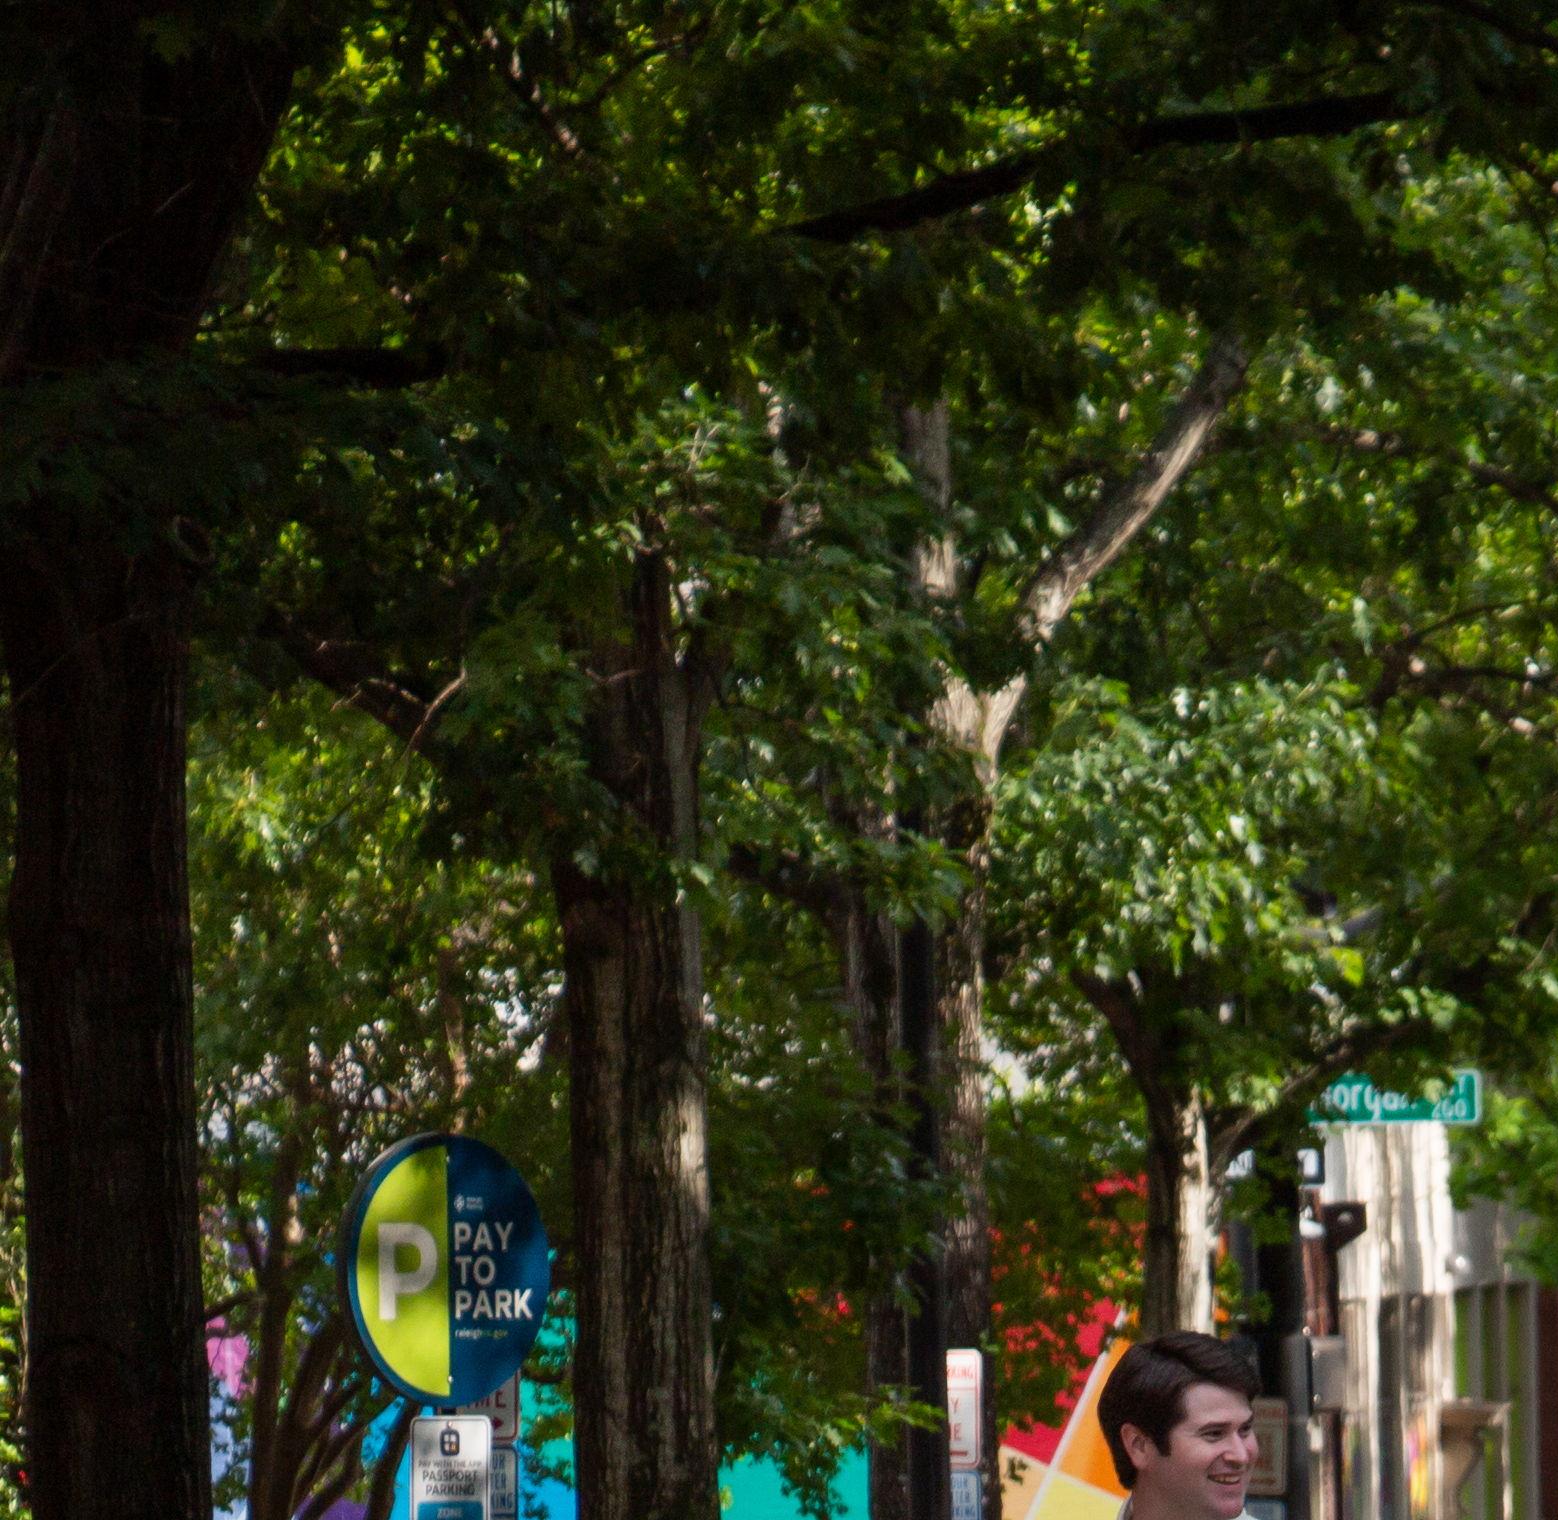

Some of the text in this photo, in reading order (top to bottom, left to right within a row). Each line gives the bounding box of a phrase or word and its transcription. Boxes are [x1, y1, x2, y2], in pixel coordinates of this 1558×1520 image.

[1310, 1082, 1418, 1121] orga
[454, 1221, 514, 1251] PAY
[377, 1221, 438, 1321] P
[455, 1255, 496, 1286] TO
[455, 1288, 533, 1320] PARK
[422, 1469, 478, 1482] PASSPORT
[425, 1483, 475, 1496] PARKING
[437, 1507, 462, 1519] ZONE
